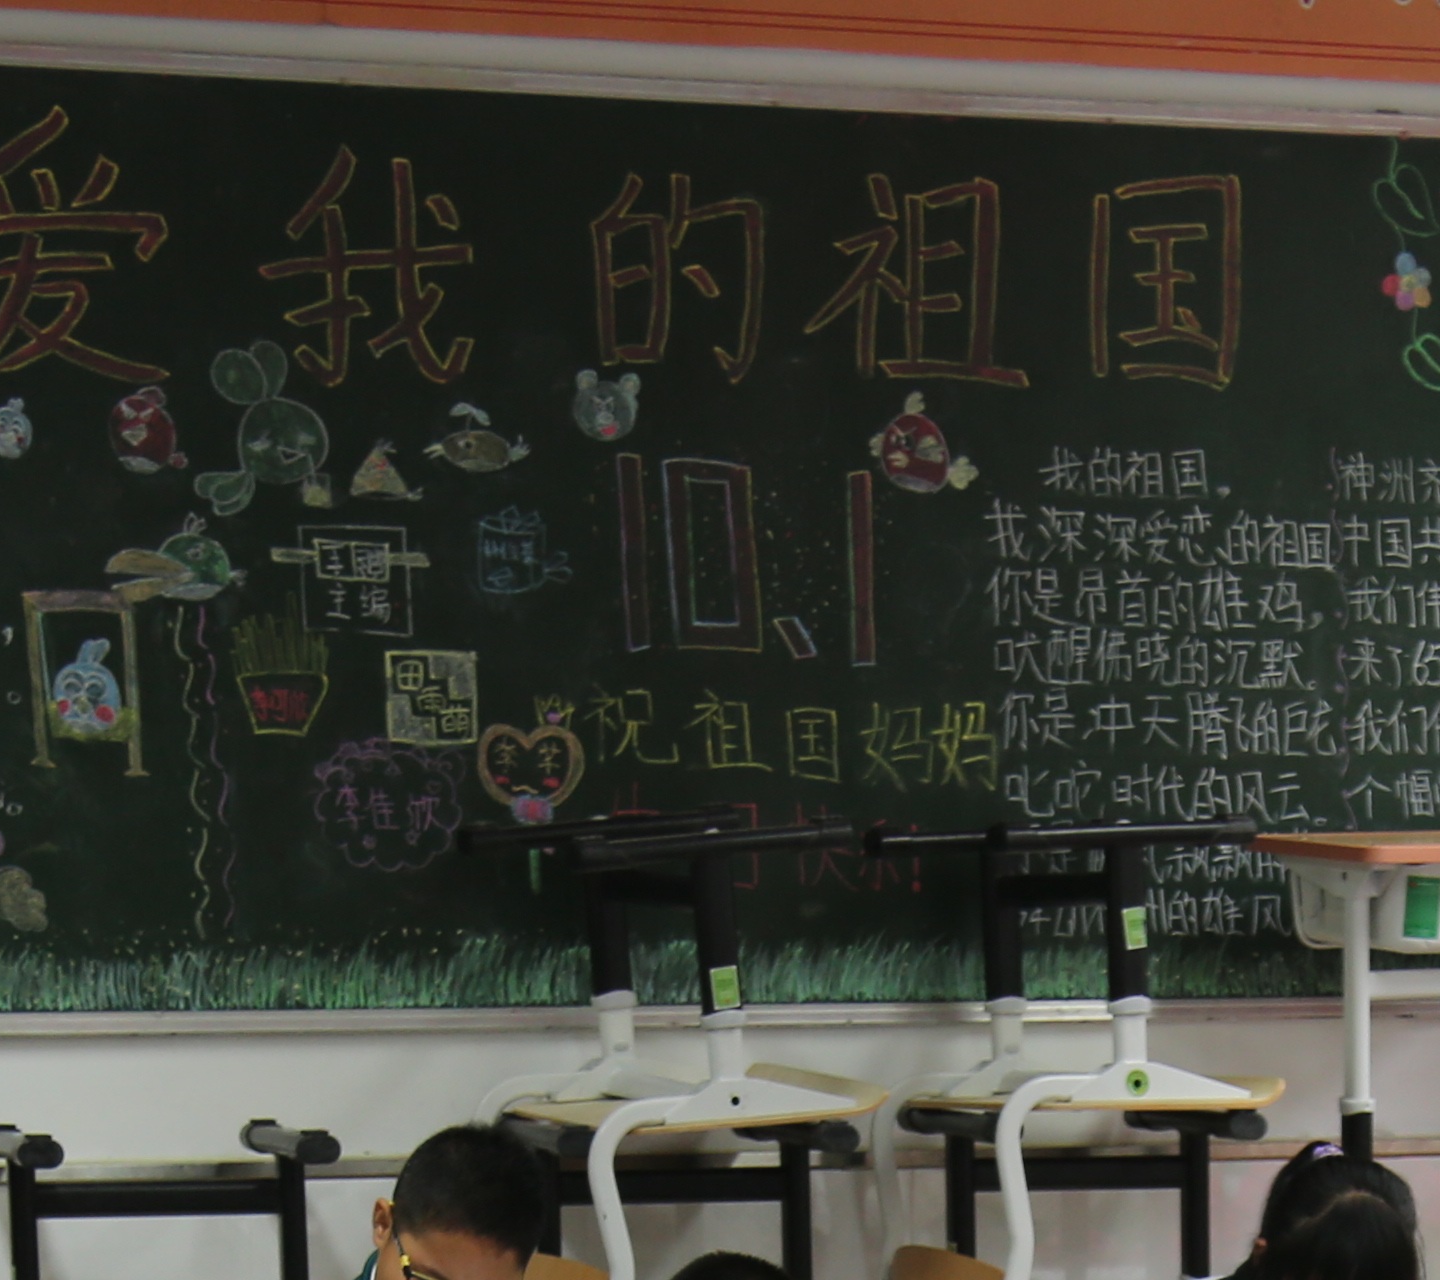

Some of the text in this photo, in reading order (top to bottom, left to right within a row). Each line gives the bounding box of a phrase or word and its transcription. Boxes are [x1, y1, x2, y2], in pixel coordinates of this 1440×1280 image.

[582, 682, 998, 793] 祝祖国妈妈
